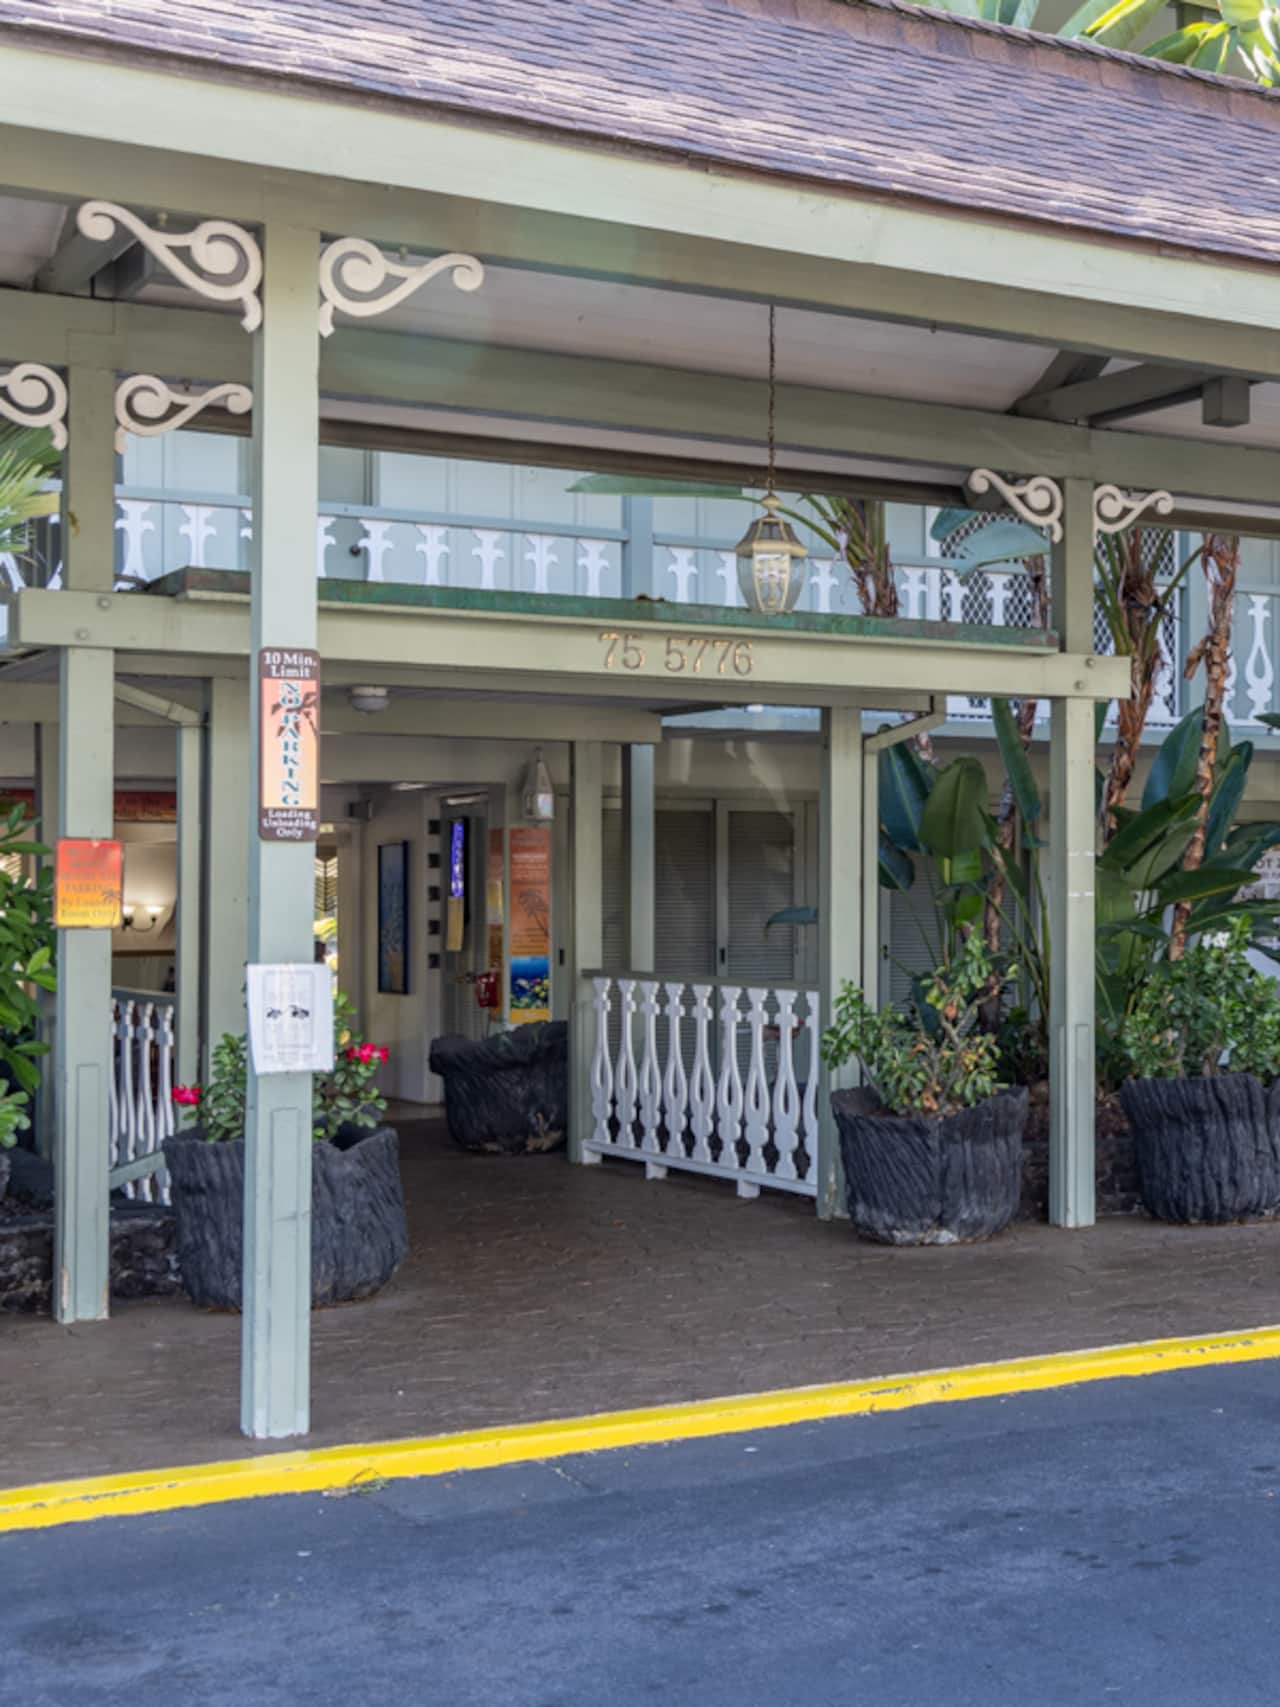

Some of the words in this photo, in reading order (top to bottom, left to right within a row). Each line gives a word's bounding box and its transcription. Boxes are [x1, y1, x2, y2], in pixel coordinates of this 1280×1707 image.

[264, 651, 281, 665] 10
[283, 652, 317, 667] Min.
[598, 632, 645, 670] 75
[664, 636, 753, 676] 5776
[271, 664, 311, 678] Limit
[281, 712, 301, 806] PARKING
[268, 808, 312, 820] Loading
[276, 827, 304, 840] Only
[1255, 858, 1273, 870] OT
